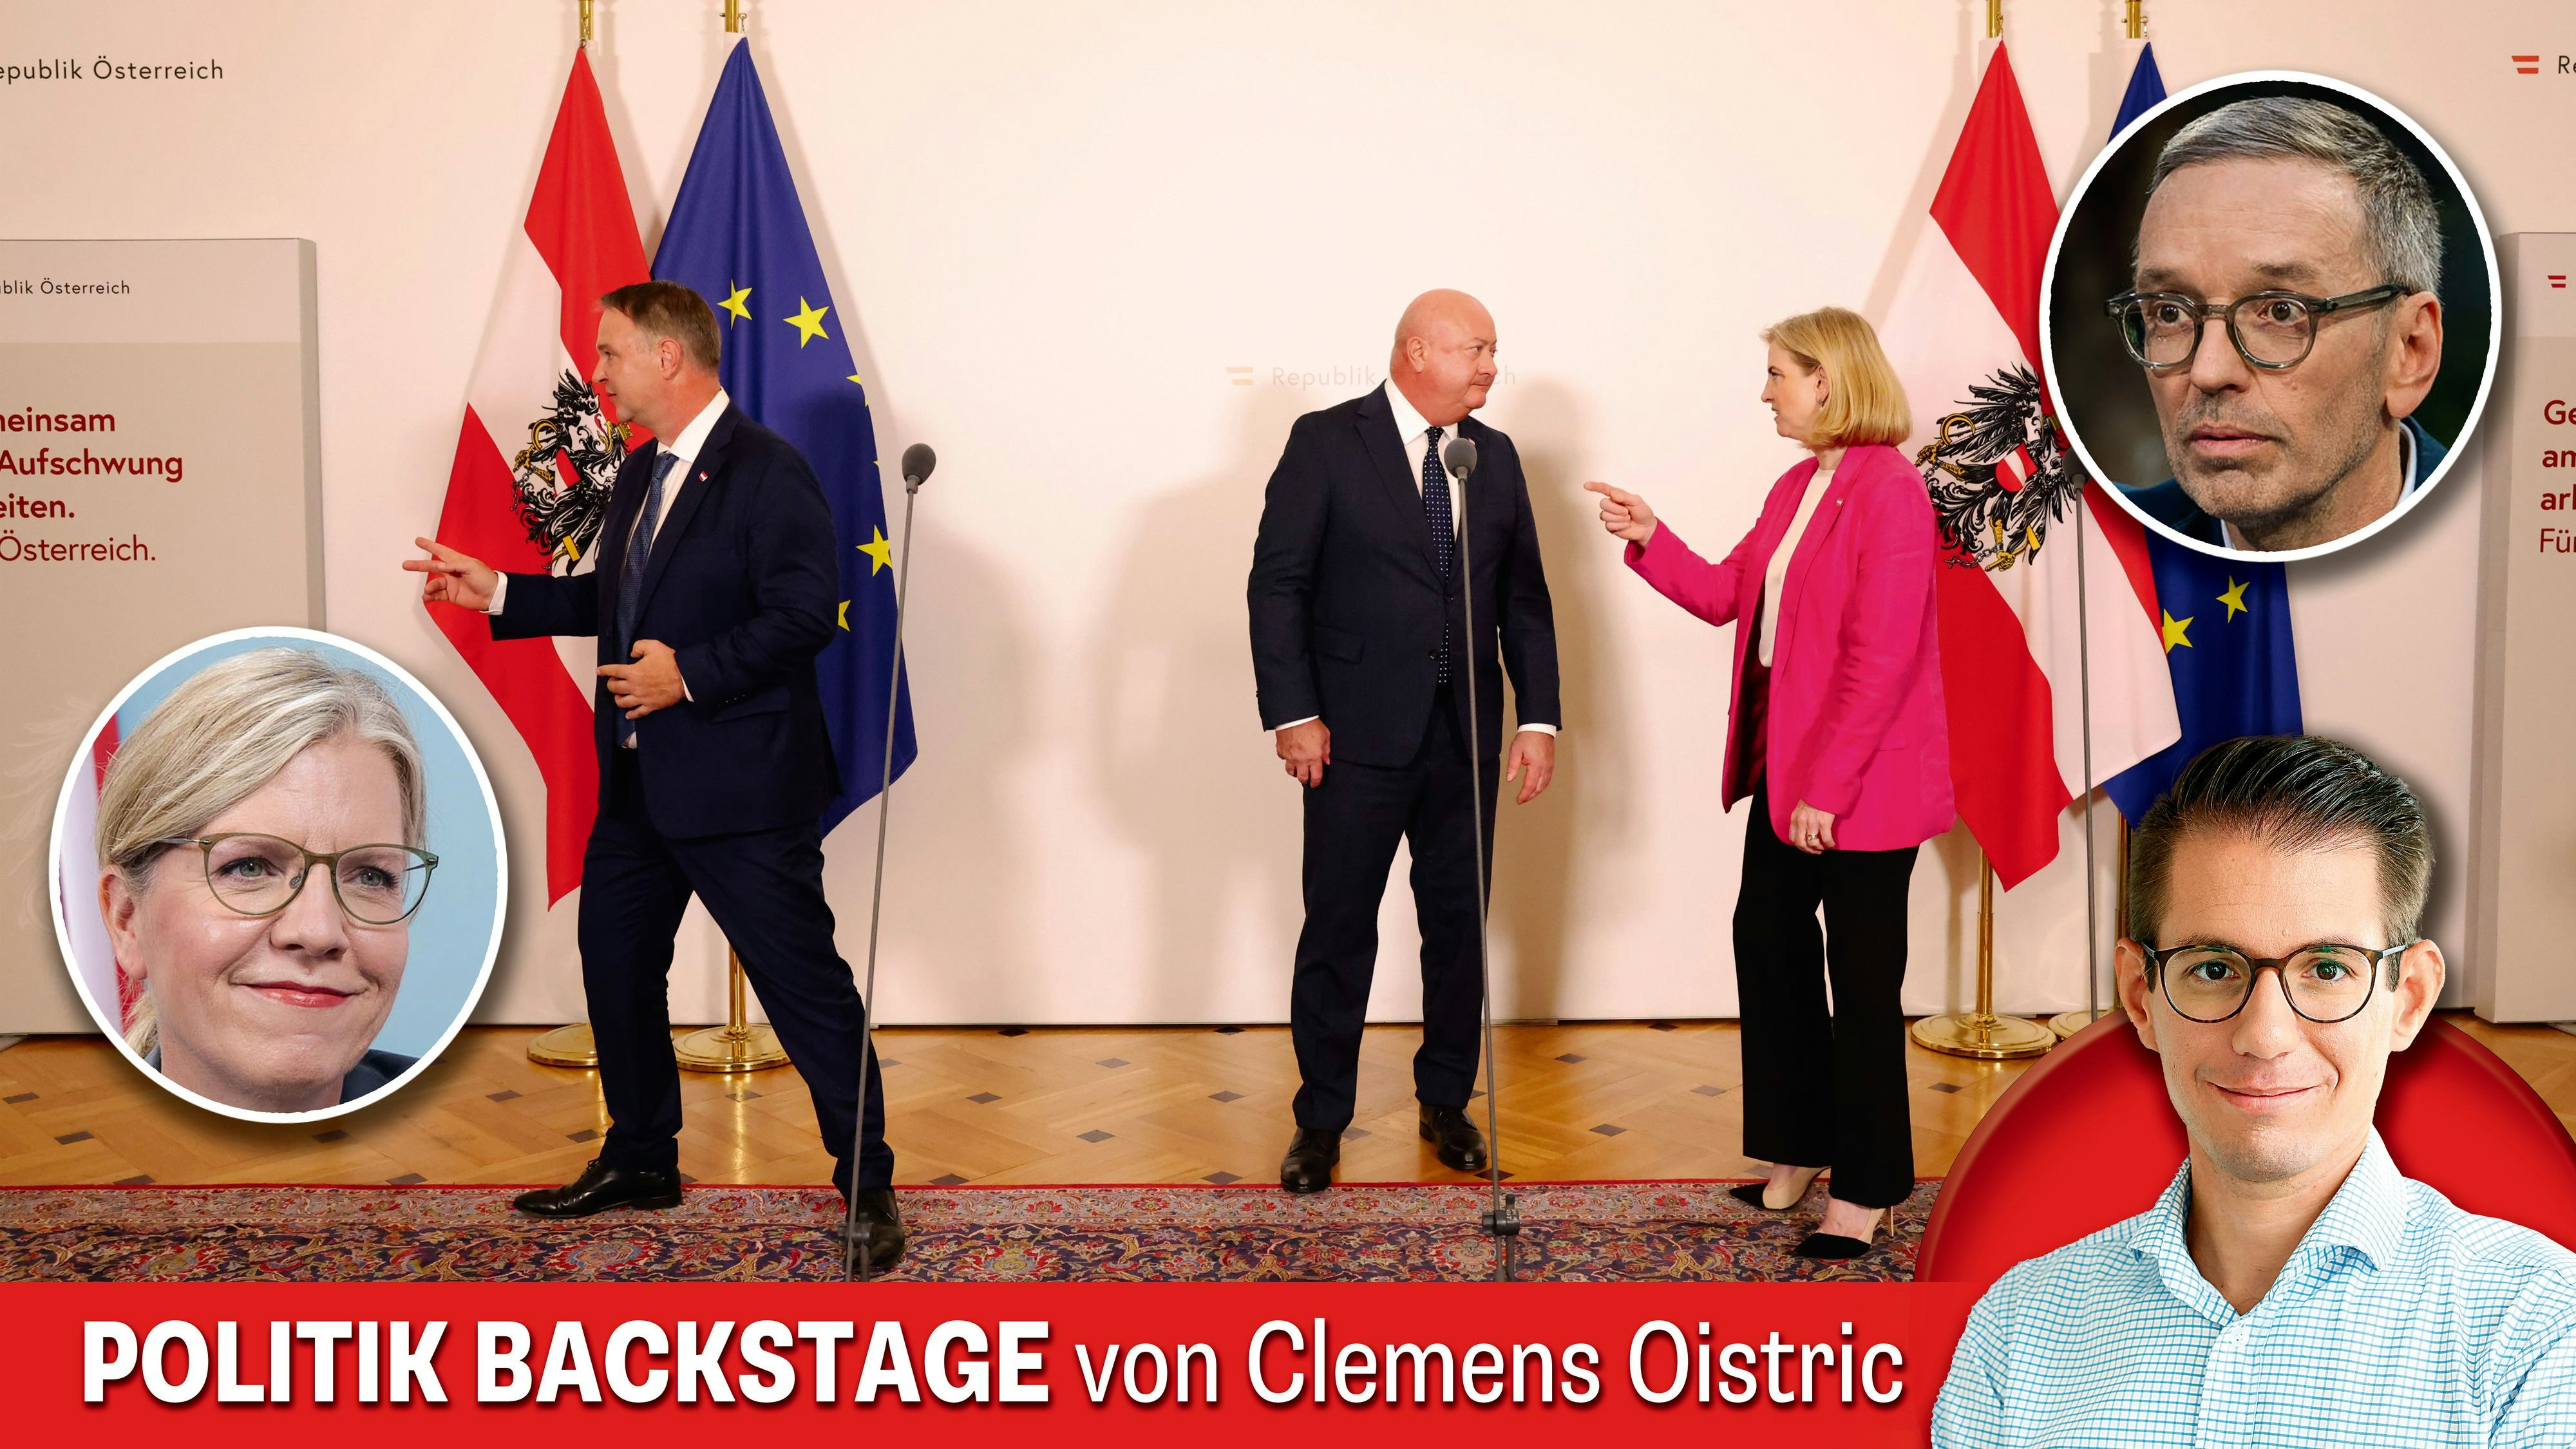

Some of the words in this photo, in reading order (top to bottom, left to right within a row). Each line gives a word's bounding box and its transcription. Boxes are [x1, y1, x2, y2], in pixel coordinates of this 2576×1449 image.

[93, 55, 223, 79] Österreich
[2559, 55, 2576, 74] R
[0, 279, 33, 294] blik
[41, 278, 129, 294] Österreich
[1273, 365, 1376, 390] Republik
[0, 406, 115, 432] einsam
[0, 448, 183, 483] Aufschwung
[2541, 484, 2576, 511] ar
[0, 529, 156, 562] Österreich.
[2540, 528, 2576, 553] Fü
